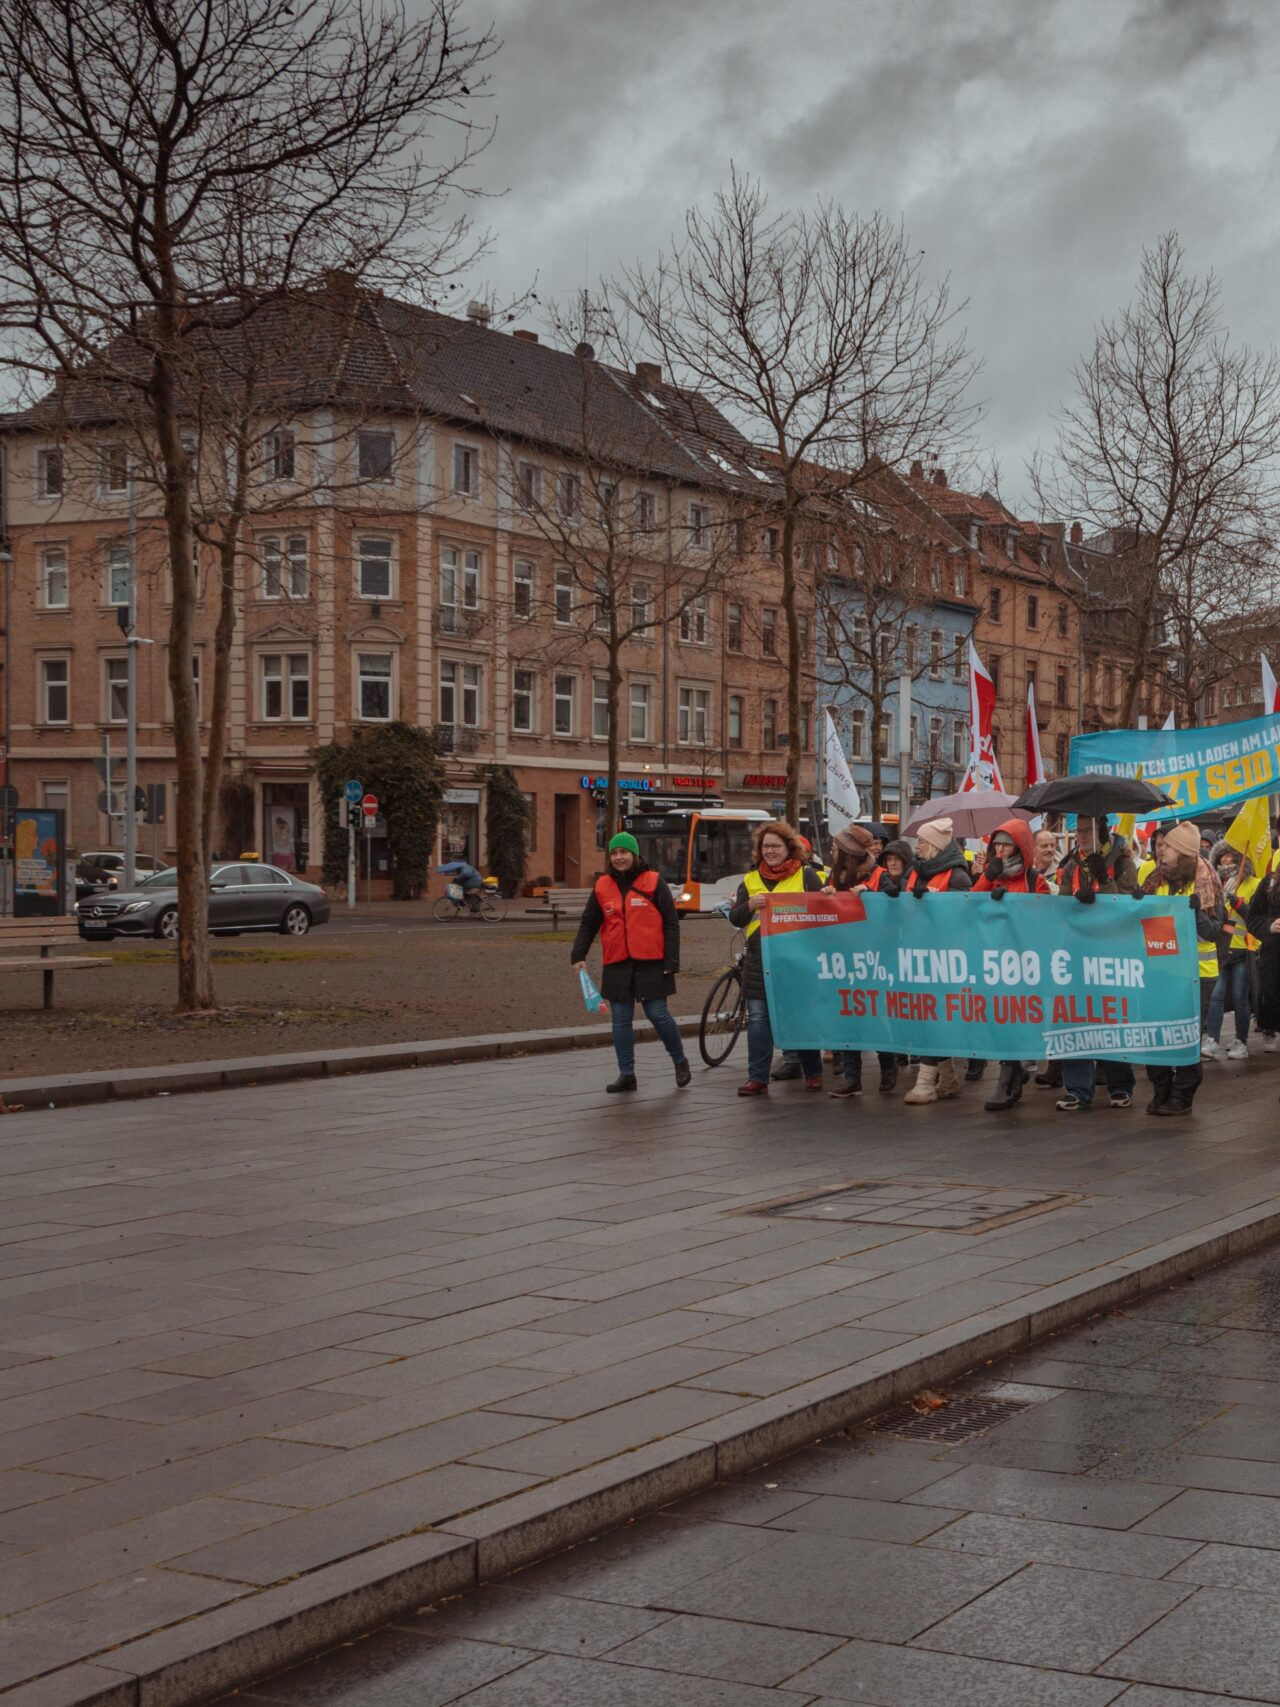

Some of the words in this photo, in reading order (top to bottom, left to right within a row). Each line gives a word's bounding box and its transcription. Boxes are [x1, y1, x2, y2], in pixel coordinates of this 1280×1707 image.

[1168, 753, 1195, 772] DEN
[1198, 741, 1239, 766] LADEN
[1242, 733, 1261, 753] AM
[1206, 749, 1273, 799] SEID
[817, 951, 895, 986] 10,5%,
[898, 948, 976, 984] MIND.
[983, 949, 1041, 986] 500
[1051, 949, 1072, 986] €
[1083, 956, 1145, 988] MEHR
[838, 989, 879, 1017] IST
[886, 991, 938, 1021] MEHR
[945, 987, 987, 1024] FÜR
[993, 995, 1044, 1024] UNS
[1052, 994, 1129, 1024] ALLE!
[1044, 1029, 1121, 1056] ZUSAMMEN
[1123, 1027, 1157, 1048] GEHT
[1162, 1021, 1200, 1046] MEHR
